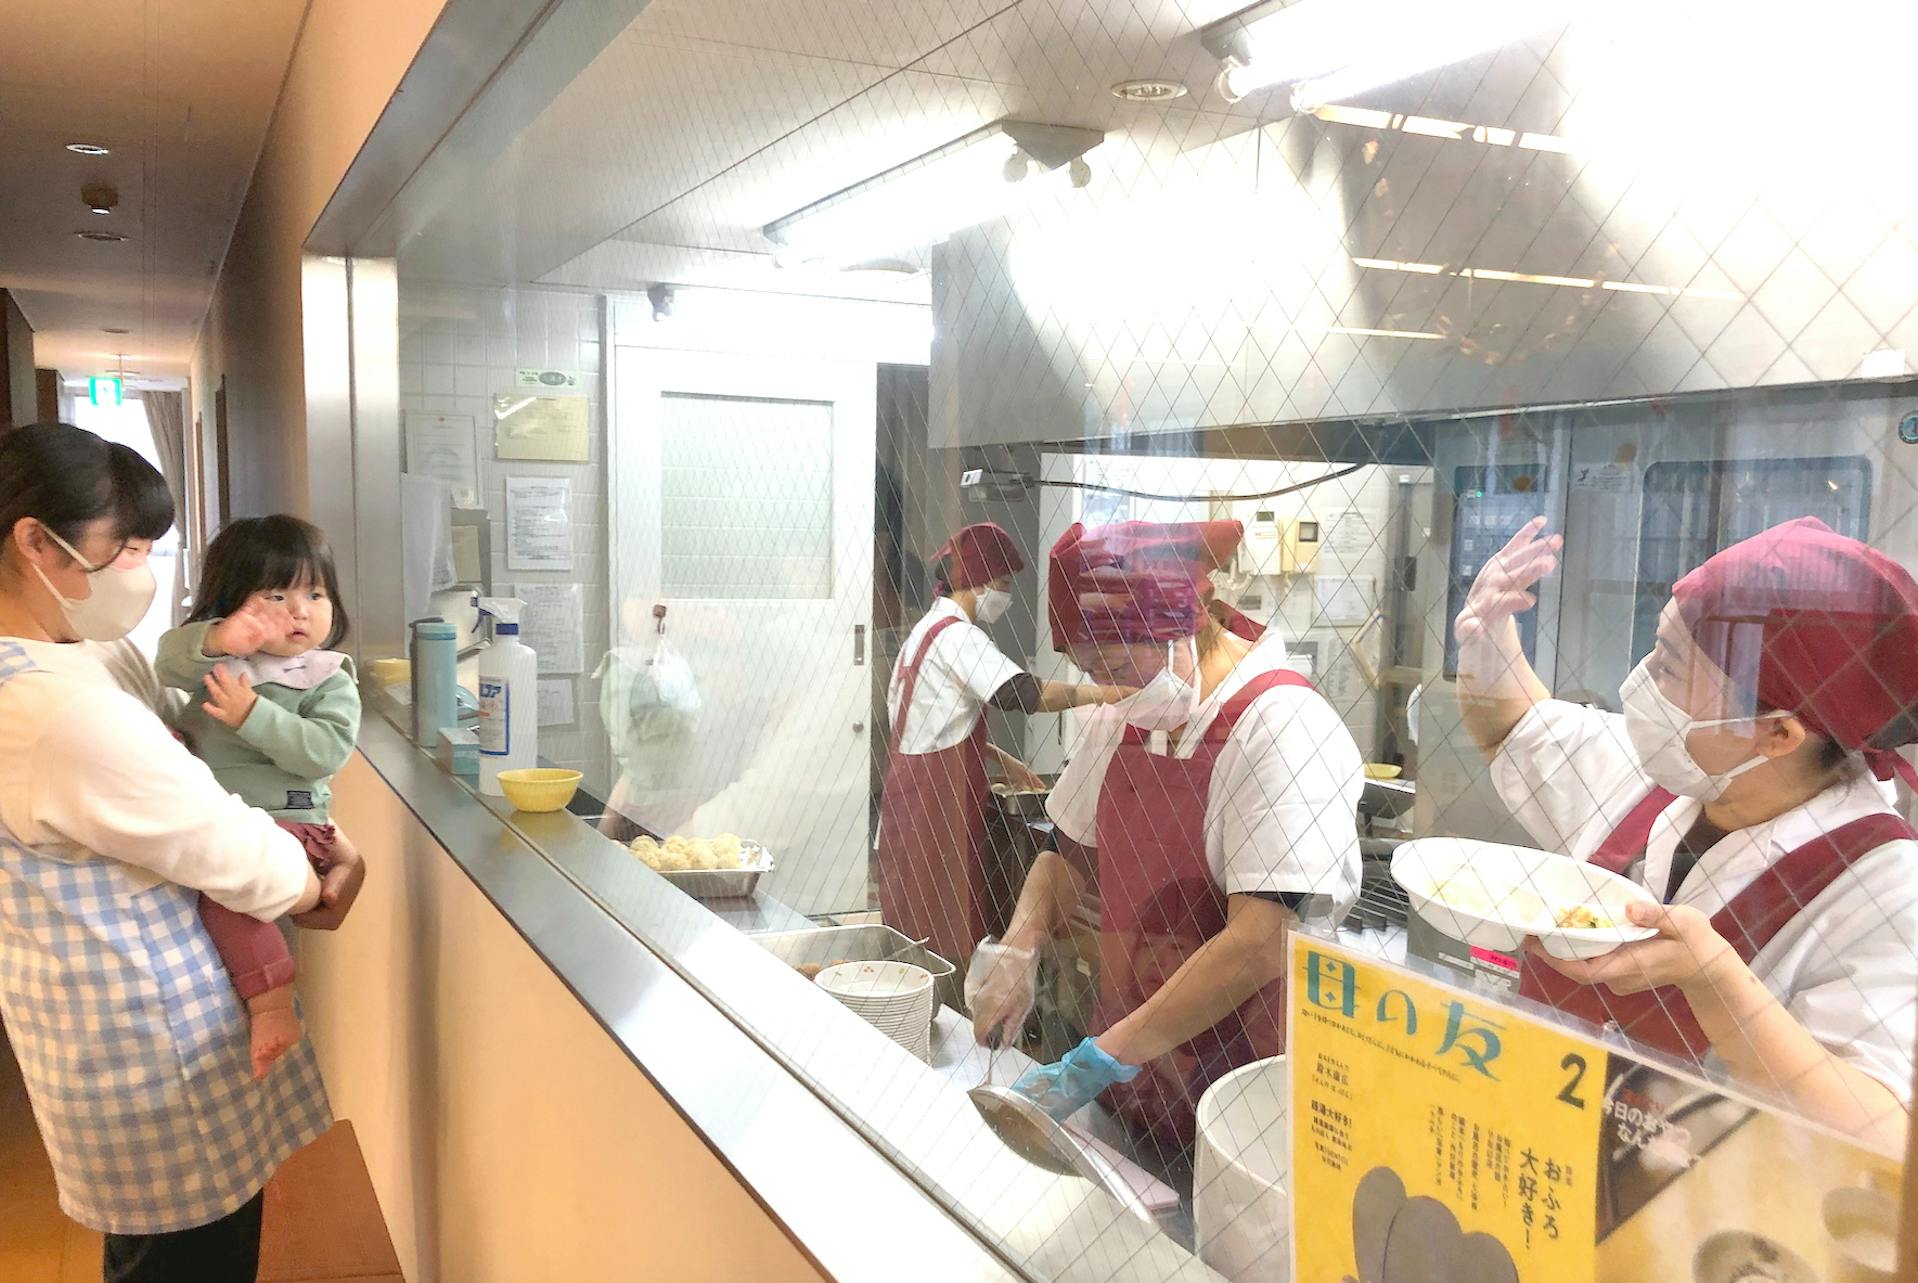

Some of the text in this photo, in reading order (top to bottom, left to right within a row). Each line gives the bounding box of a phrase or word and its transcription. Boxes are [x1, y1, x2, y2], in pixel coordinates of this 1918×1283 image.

[1302, 950, 1507, 1082] 母の友
[1555, 1053, 1586, 1110] 2
[1541, 1156, 1562, 1241] おふろ
